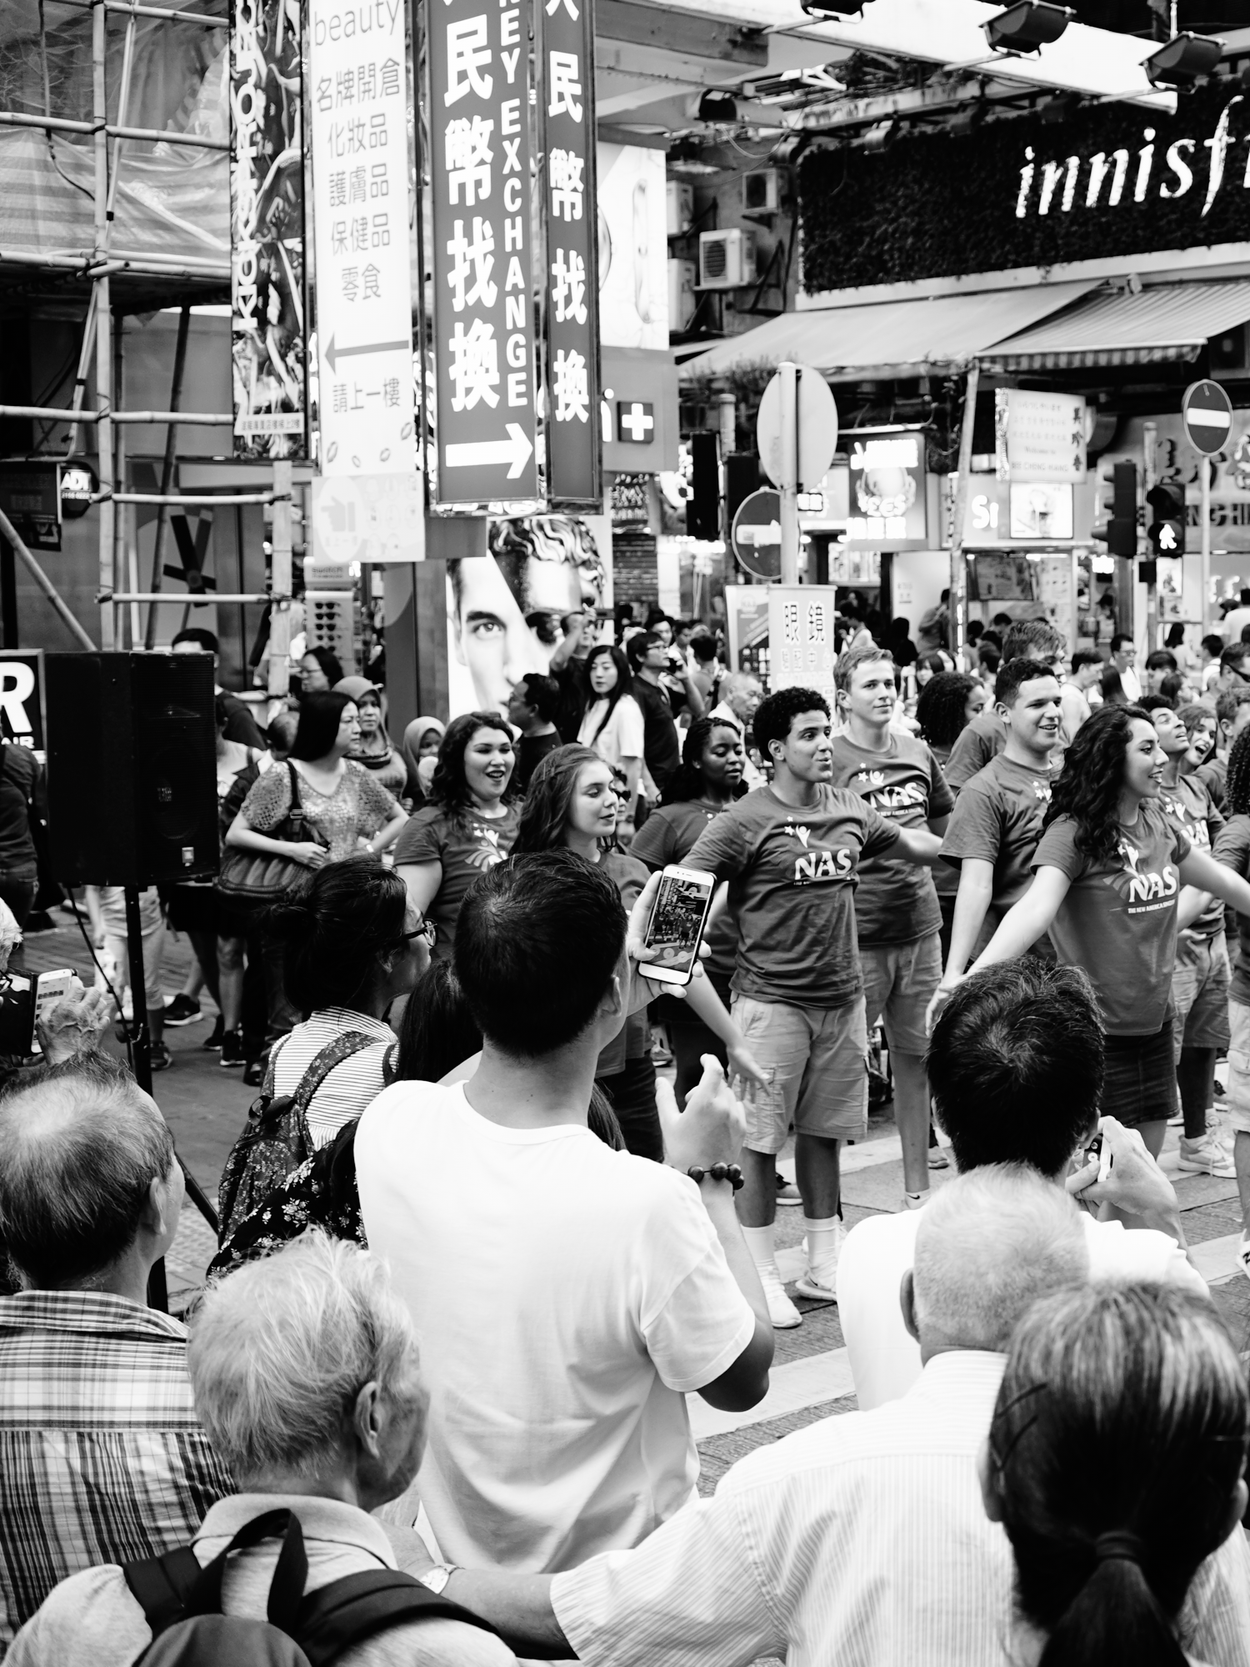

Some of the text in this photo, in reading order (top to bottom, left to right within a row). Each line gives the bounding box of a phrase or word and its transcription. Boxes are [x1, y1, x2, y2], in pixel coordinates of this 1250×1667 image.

[314, 0, 401, 47] beauty
[315, 57, 401, 113] 名牌開倉
[327, 113, 388, 159] 化妝品
[328, 163, 390, 207] 護膚品
[443, 0, 500, 412] 民幣找換
[330, 213, 391, 257] 保健品
[501, 98, 528, 408] EXCHANGE
[341, 263, 381, 302] 零食
[332, 377, 401, 414] 請上一樓
[61, 472, 92, 491] ADT
[784, 603, 824, 642] 眼鏡
[869, 782, 925, 808] NAS
[794, 848, 852, 880] NAS
[1128, 865, 1178, 903] NAS
